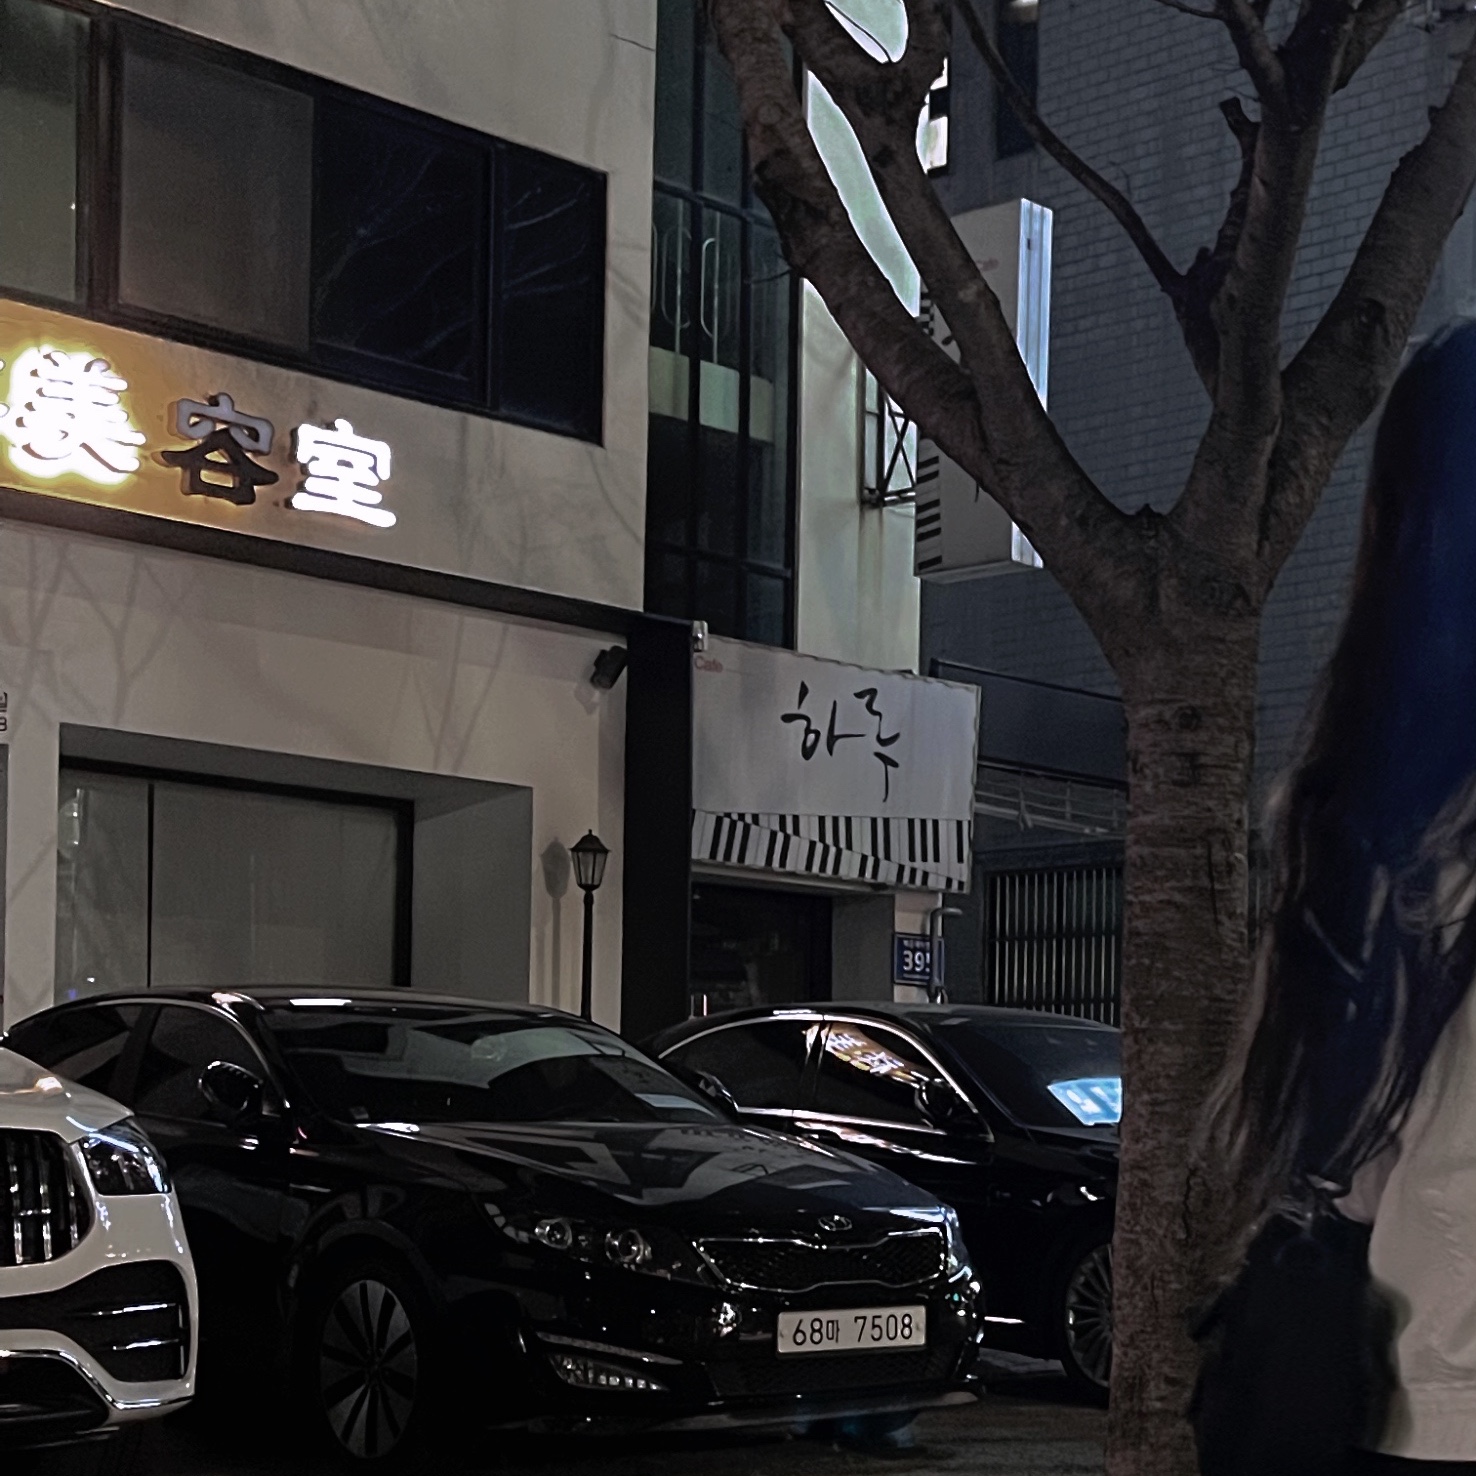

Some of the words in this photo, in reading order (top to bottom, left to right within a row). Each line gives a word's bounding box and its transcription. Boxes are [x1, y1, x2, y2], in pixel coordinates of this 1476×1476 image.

[8, 345, 397, 528] 美容室
[780, 680, 900, 802] 하루
[793, 1317, 840, 1346] 68마
[854, 1313, 913, 1342] 7508
